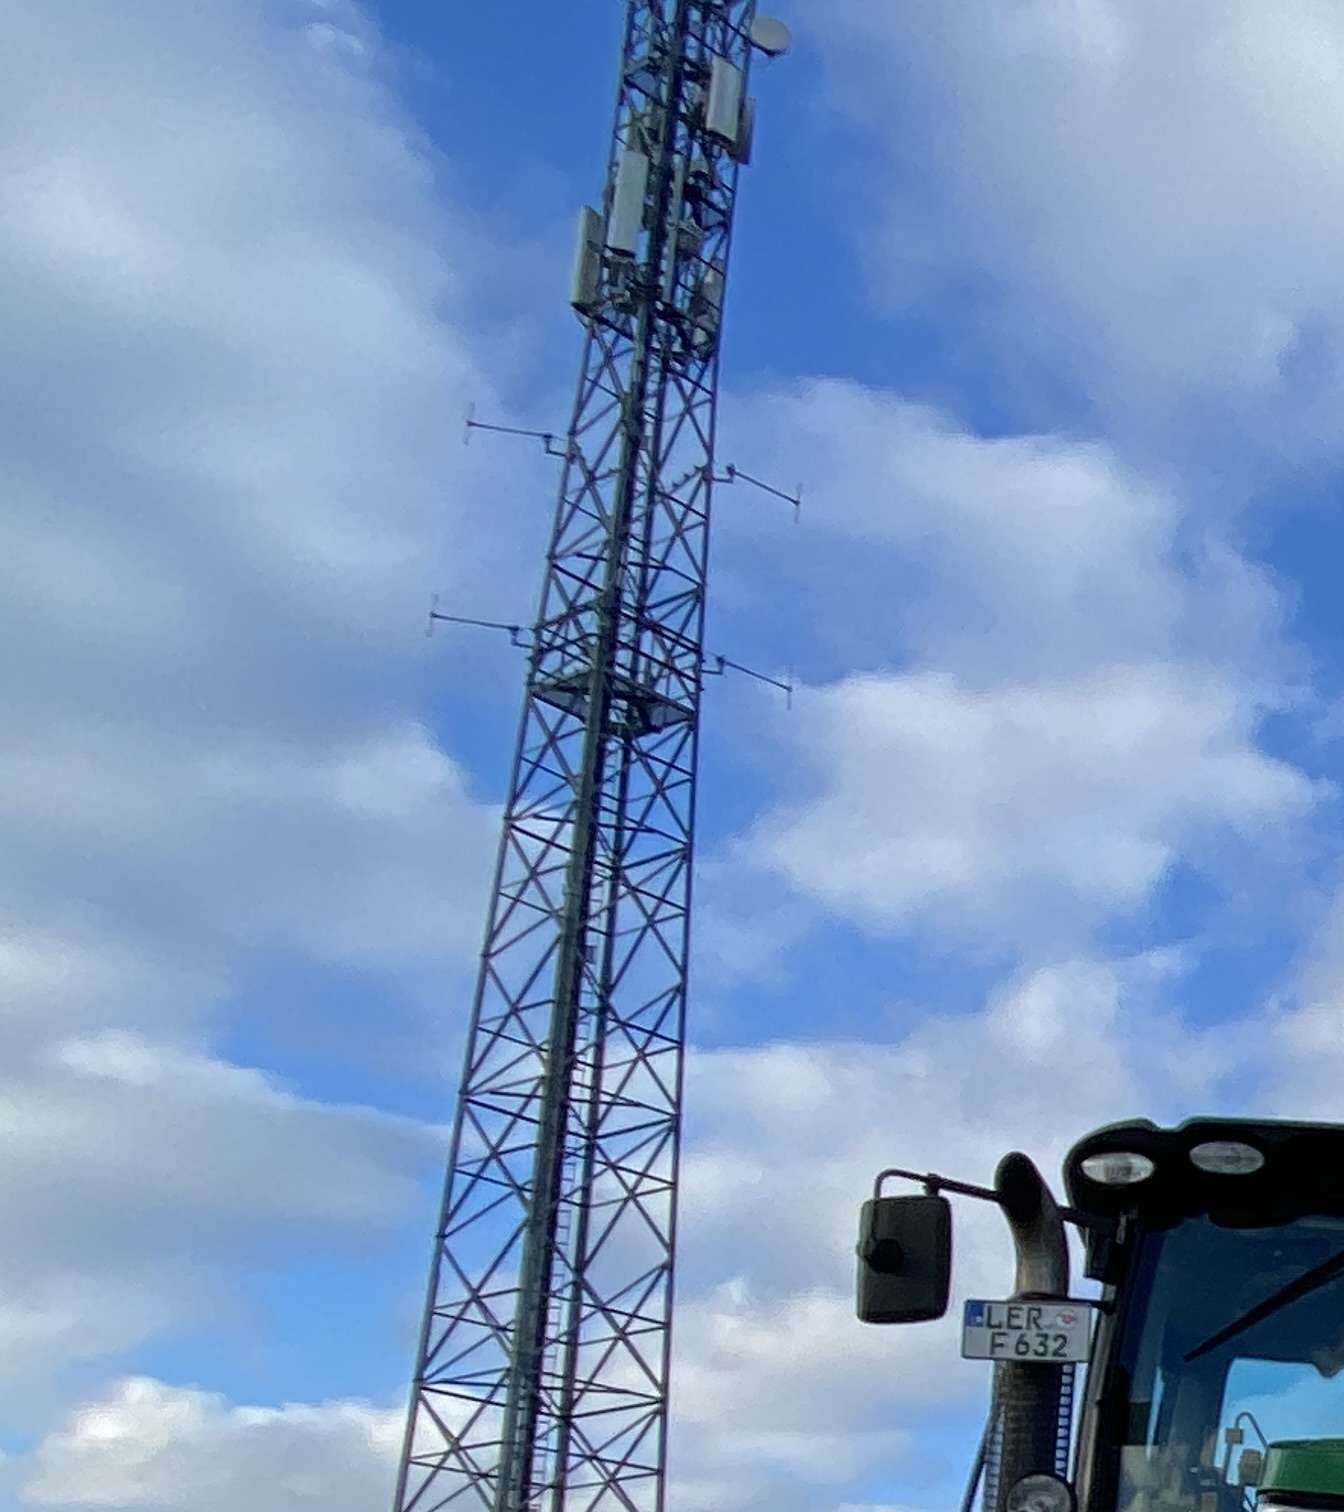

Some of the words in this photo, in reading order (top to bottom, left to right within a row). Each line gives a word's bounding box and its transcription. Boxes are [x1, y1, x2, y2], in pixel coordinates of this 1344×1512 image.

[986, 1305, 1042, 1330] LER
[990, 1332, 1008, 1355] F
[1015, 1333, 1067, 1357] 632
